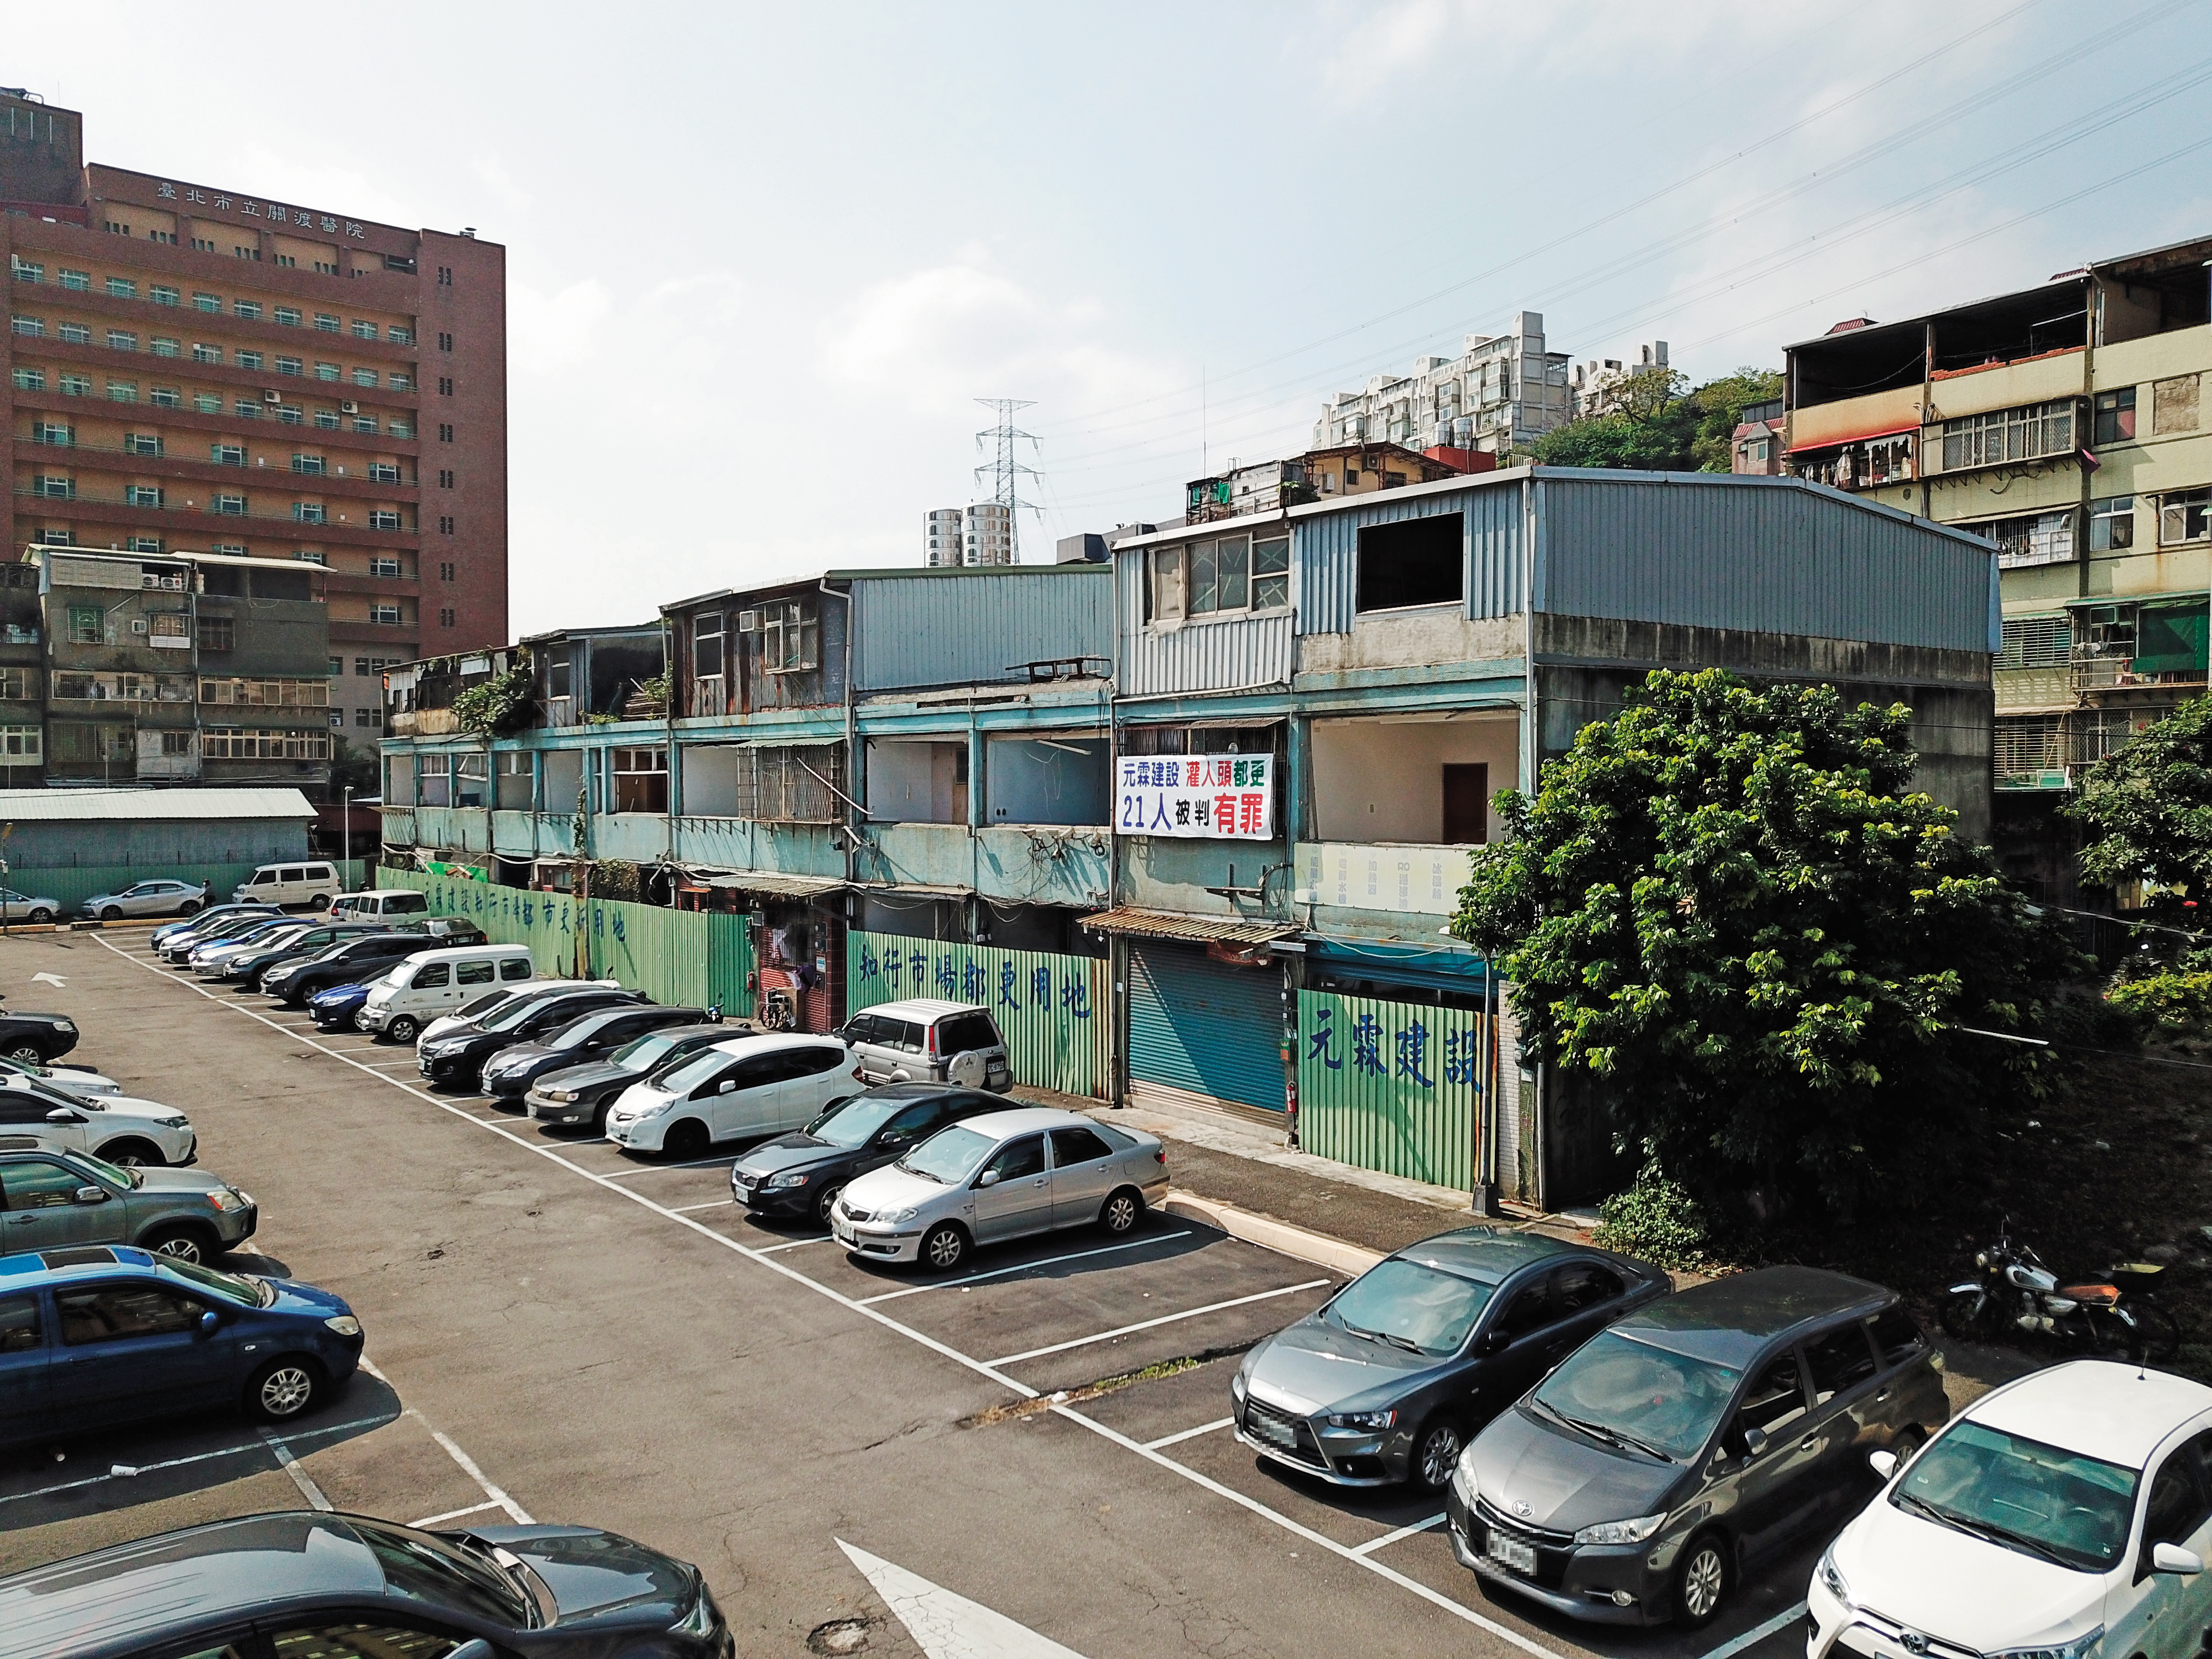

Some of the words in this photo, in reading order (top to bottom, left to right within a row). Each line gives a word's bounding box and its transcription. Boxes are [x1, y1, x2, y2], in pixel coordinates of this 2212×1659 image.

[157, 182, 364, 239] 臺北市立關渡醫院
[1123, 761, 1180, 787] 元霖建設
[1186, 760, 1265, 787] 灌人頭都更
[1123, 792, 1264, 834] 21人被判有罪
[1368, 860, 1378, 895] 加熱器
[859, 944, 1091, 1018] 知行市場都更用地
[1307, 1009, 1484, 1094] 元霖建設
